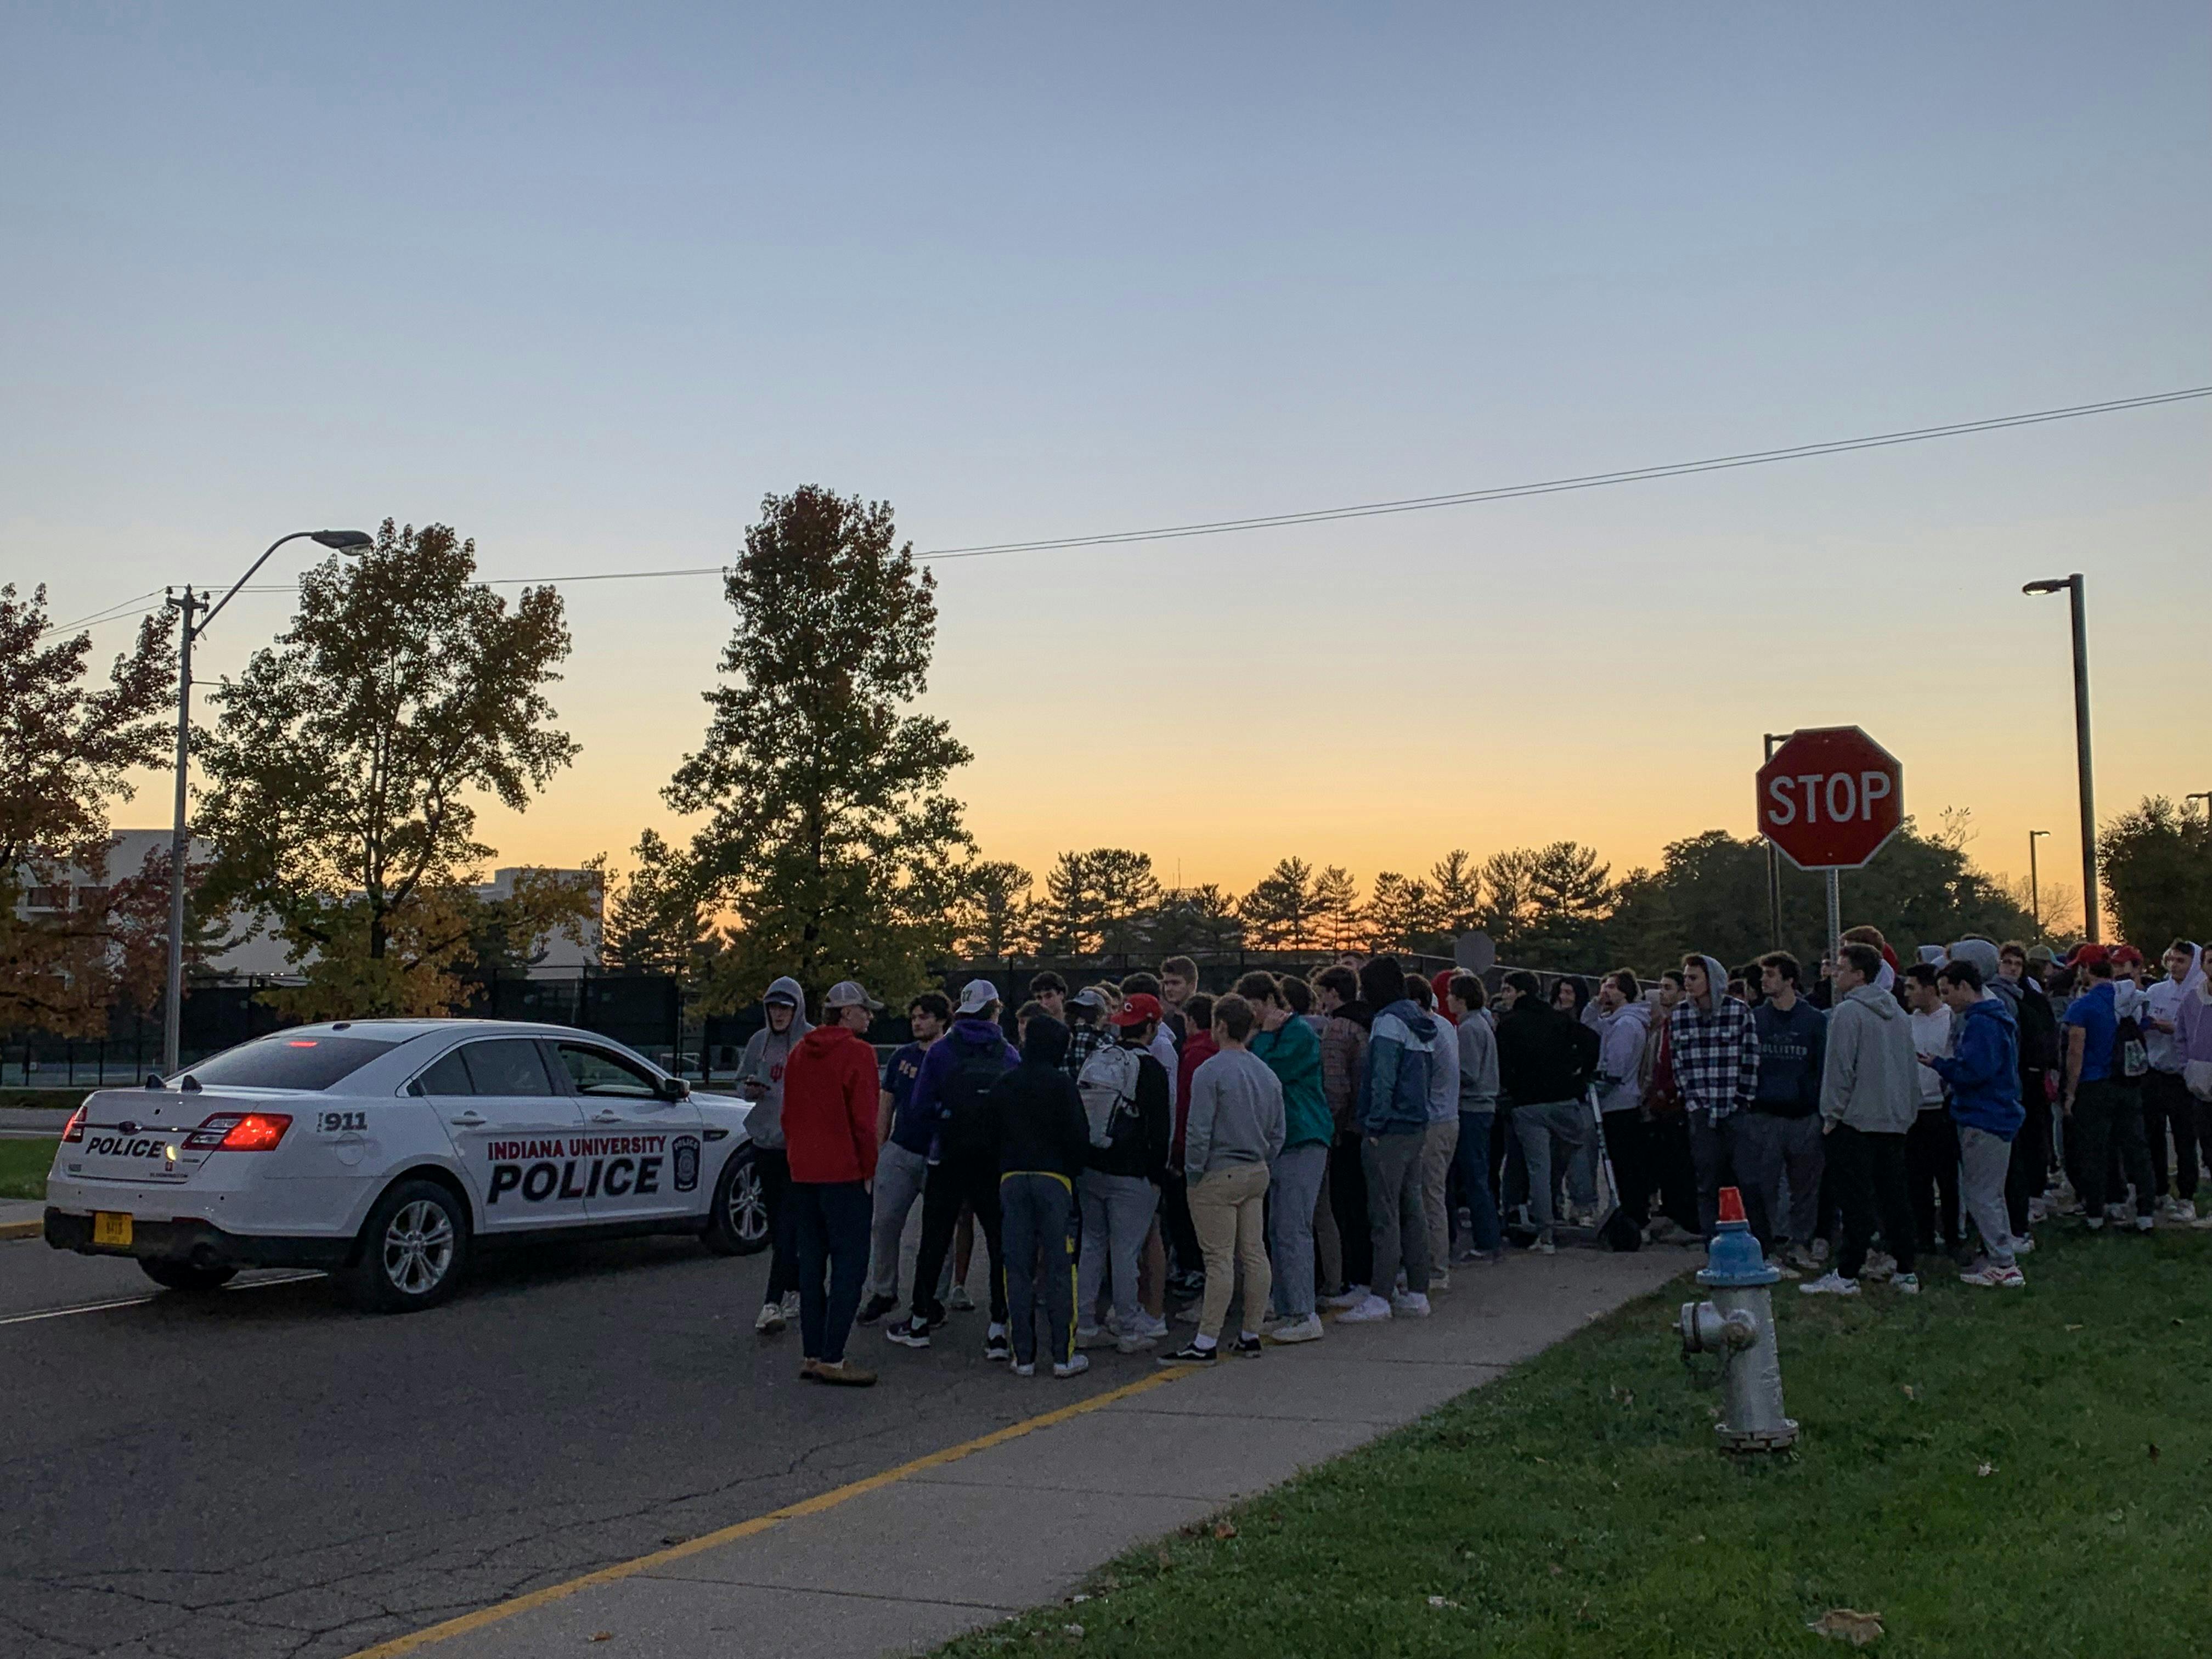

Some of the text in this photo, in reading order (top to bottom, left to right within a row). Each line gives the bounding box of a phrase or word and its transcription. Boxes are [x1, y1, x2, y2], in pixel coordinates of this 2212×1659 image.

[1768, 771, 1891, 825] STOP
[324, 1112, 368, 1131] 911
[86, 1137, 166, 1158] POLICE
[488, 1136, 667, 1160] INDIANA UNIVERSITY
[487, 1158, 663, 1204] POLICE
